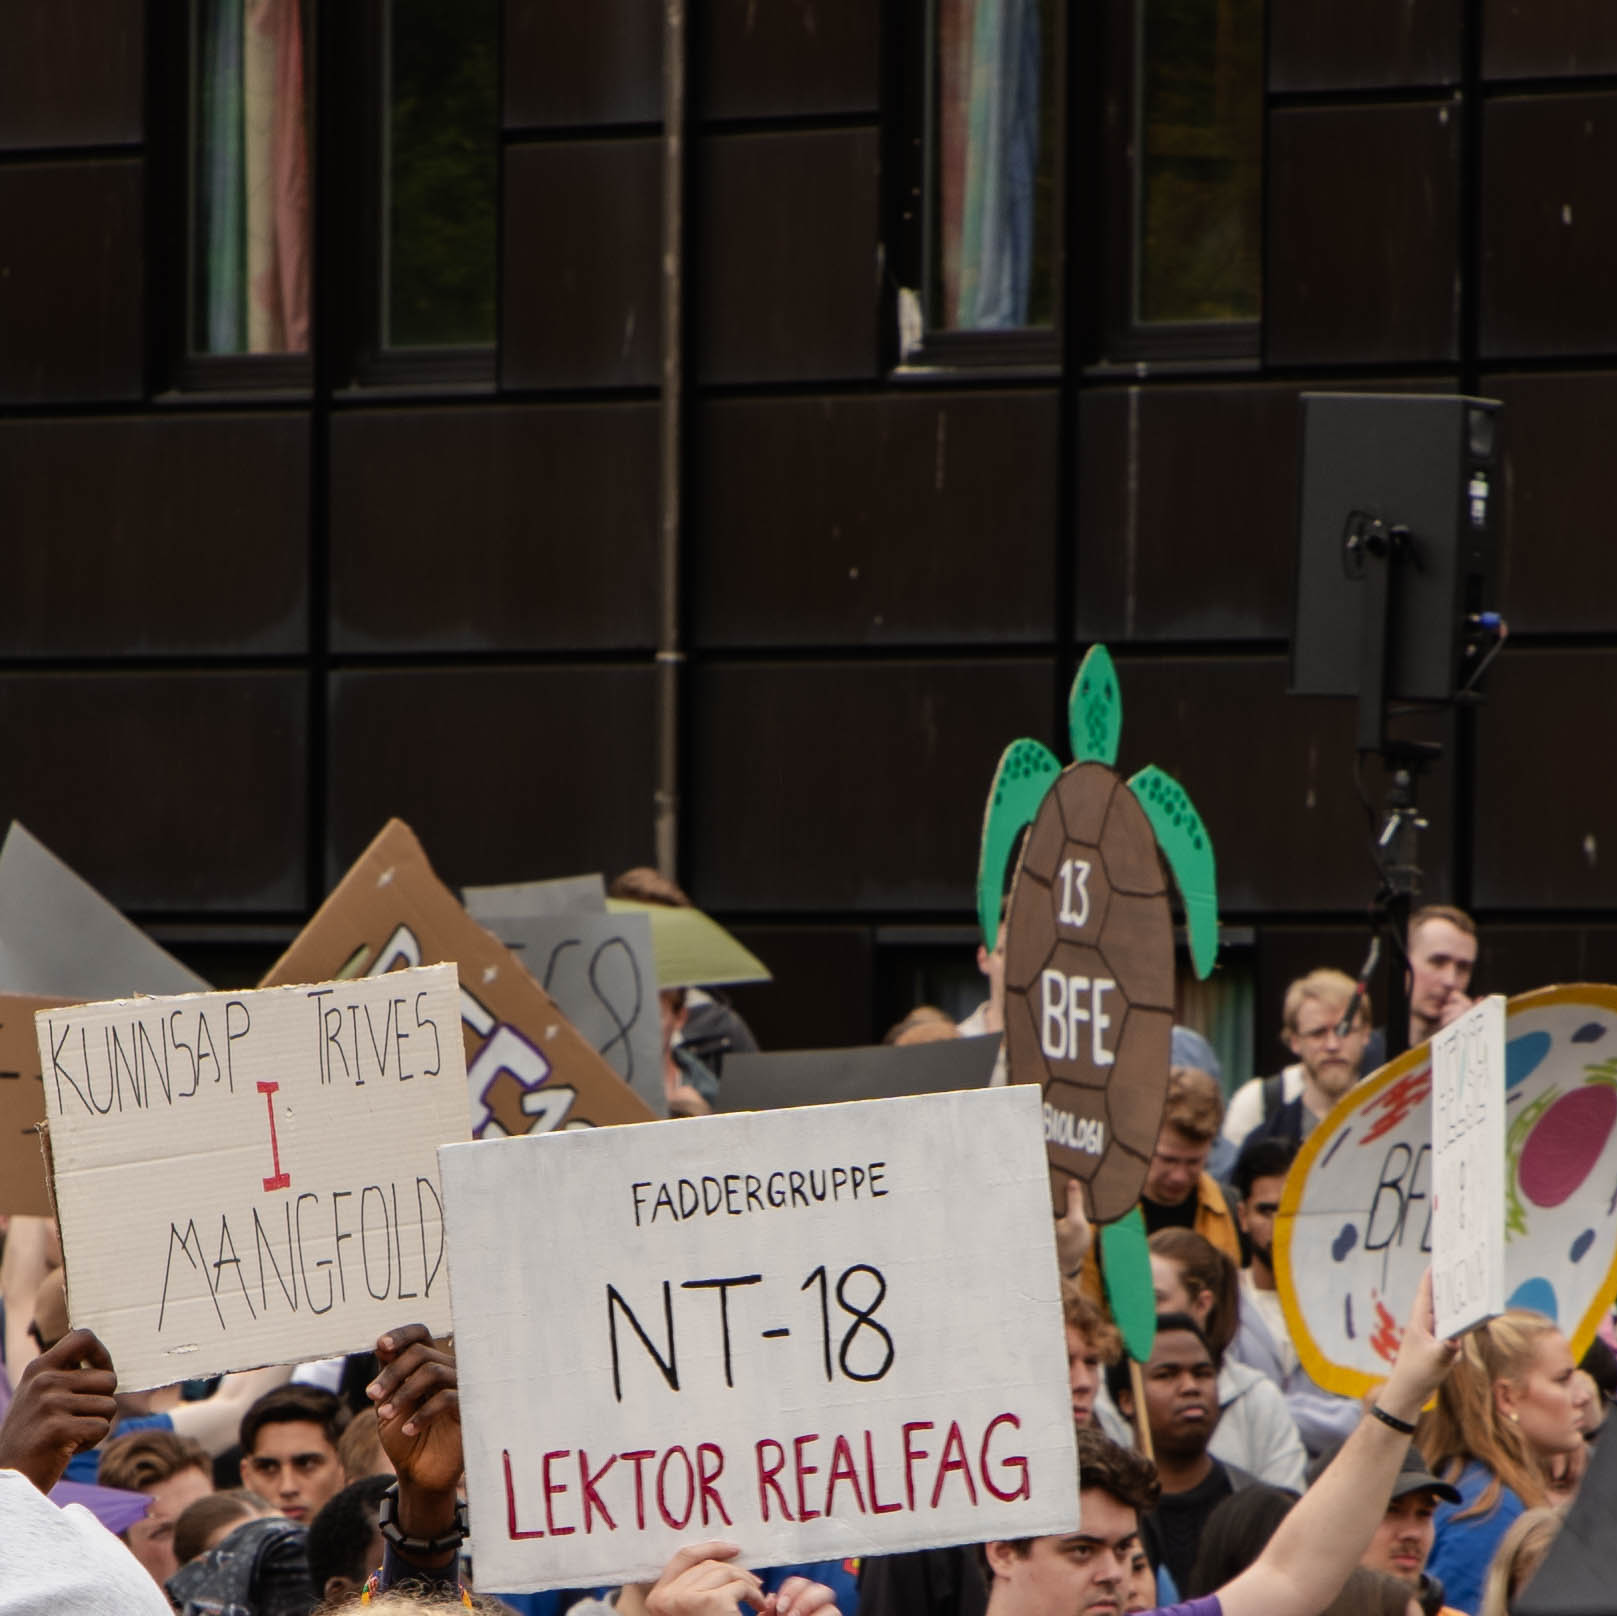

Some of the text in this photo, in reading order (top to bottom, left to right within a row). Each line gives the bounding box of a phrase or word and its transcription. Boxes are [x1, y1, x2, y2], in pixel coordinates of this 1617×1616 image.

[1058, 858, 1091, 927] 13
[47, 1000, 251, 1116] KUNNSAP
[307, 988, 441, 1087] TRIVES
[1040, 967, 1117, 1068] BFE
[256, 1081, 291, 1192] I
[1042, 1101, 1104, 1156] BIOLOGI
[630, 1161, 890, 1227] FADDERGRUPPE
[157, 1176, 447, 1332] MANGFOLD
[605, 1263, 896, 1404] NT-18
[502, 1412, 1031, 1541] LEKTOR REALFAG
